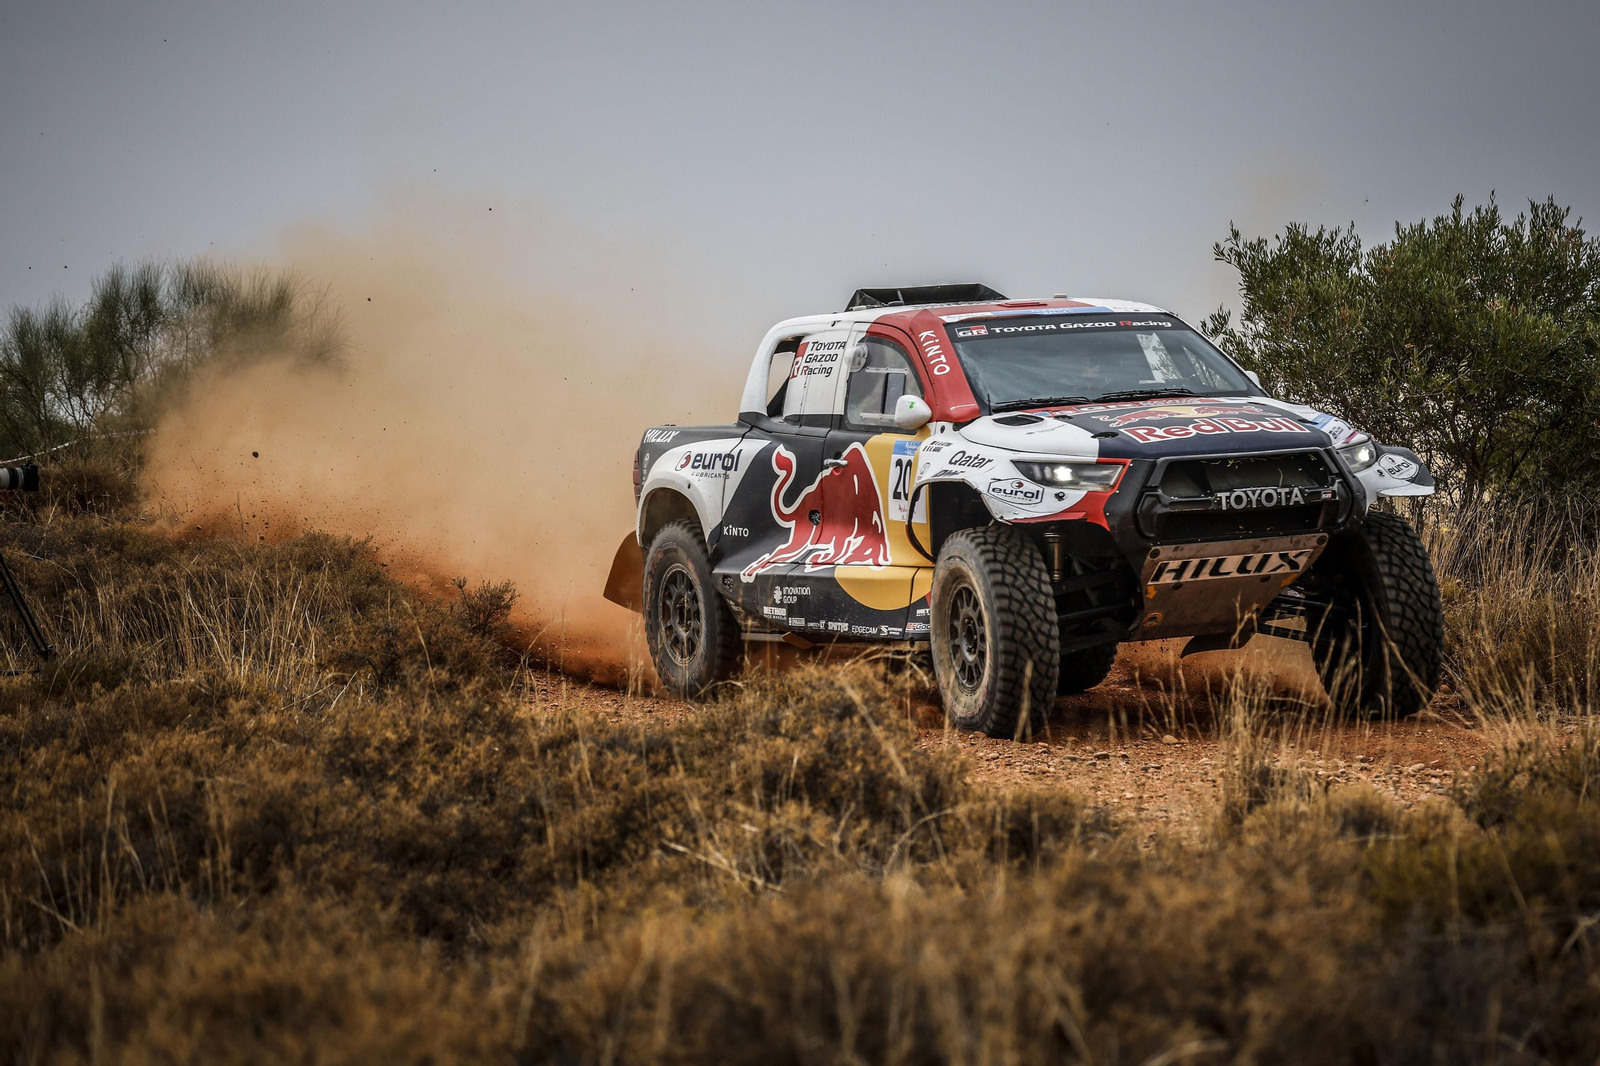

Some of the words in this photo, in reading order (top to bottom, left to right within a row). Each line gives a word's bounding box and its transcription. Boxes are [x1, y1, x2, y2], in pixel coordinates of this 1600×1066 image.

[957, 327, 987, 337] GR
[991, 324, 1057, 334] TOYOTA
[1060, 322, 1117, 330] GAZOO
[1119, 320, 1172, 328] Racing
[810, 341, 847, 351] TOYOTA
[804, 353, 838, 363] GAZOO
[800, 365, 833, 378] Racing
[643, 429, 680, 443] HILUX
[1121, 418, 1228, 442] Red
[1215, 417, 1309, 432] Bull
[691, 449, 743, 472] eurol
[948, 450, 994, 468] Qatar
[1387, 459, 1413, 476] eurol
[691, 472, 730, 480] LUBRICANTS
[991, 487, 1040, 499] eurol
[1217, 488, 1305, 510] TOYOTA
[1150, 551, 1311, 583] HILUX
[852, 625, 878, 634] EDGECAM
